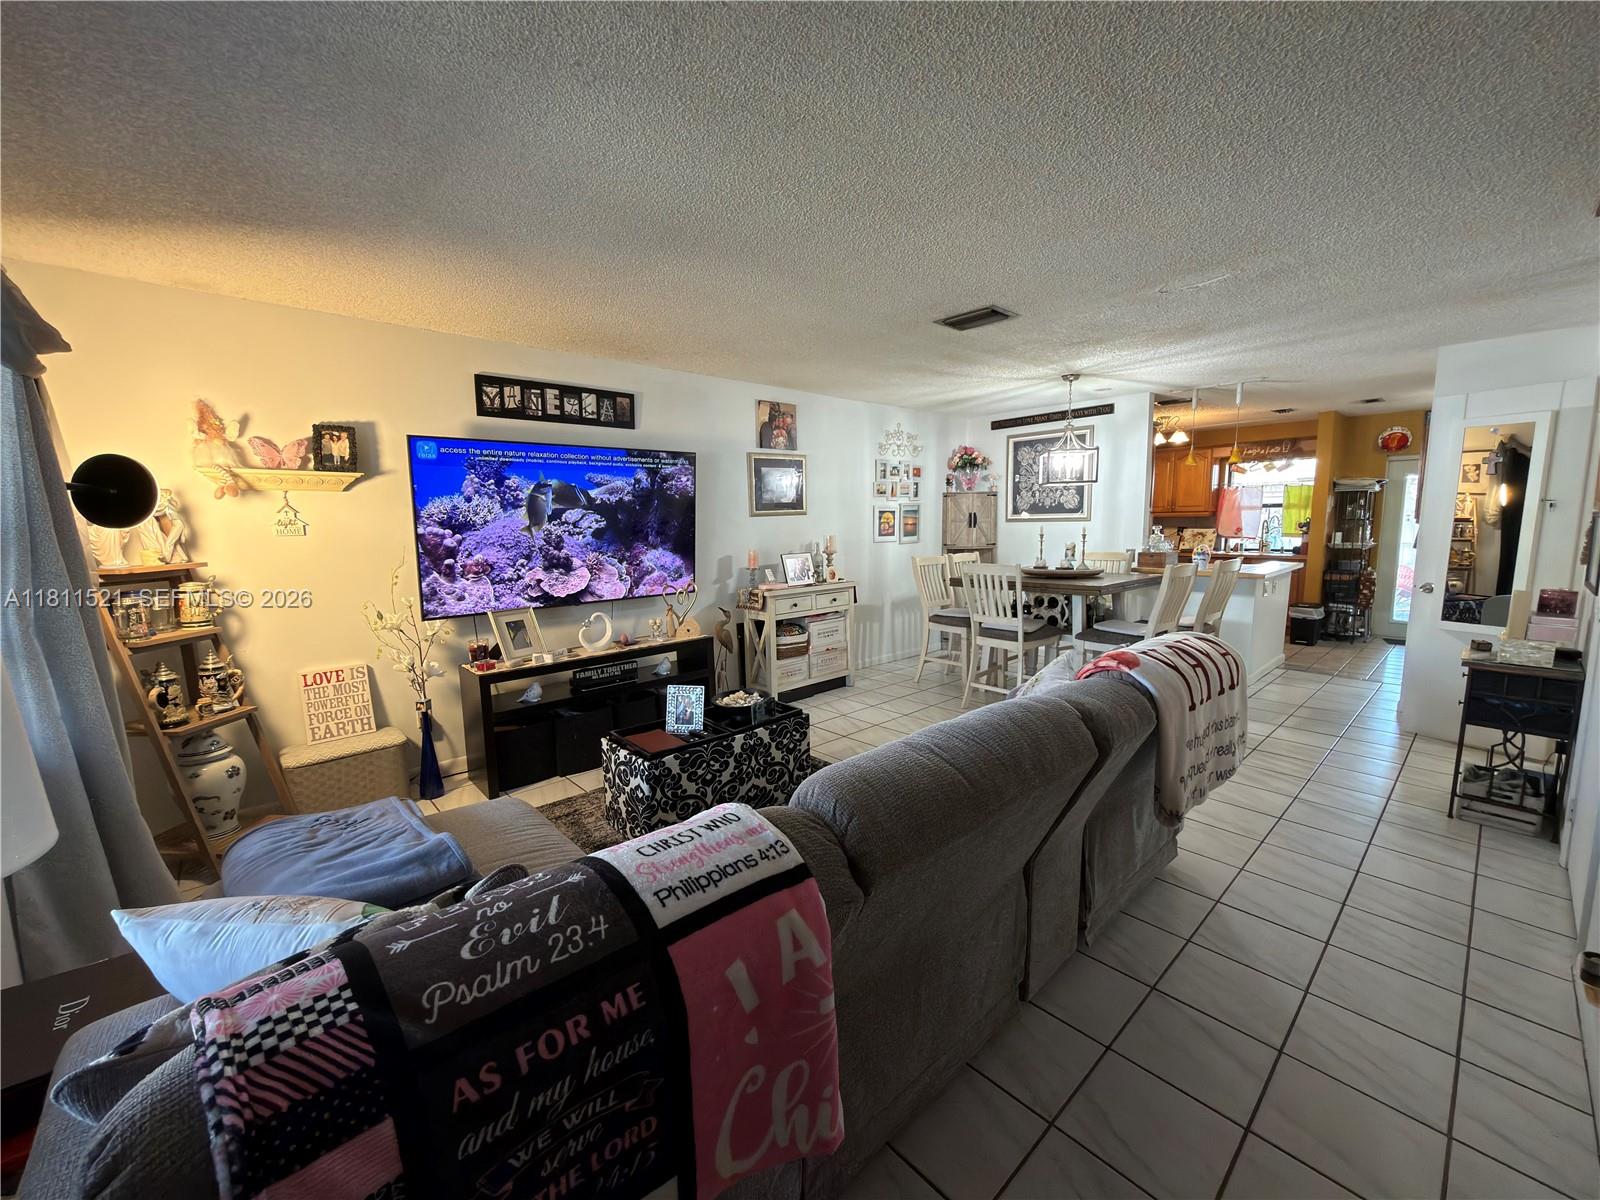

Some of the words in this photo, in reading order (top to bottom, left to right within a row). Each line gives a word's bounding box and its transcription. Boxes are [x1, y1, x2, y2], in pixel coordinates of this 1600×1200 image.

[483, 448, 503, 456] entire
[504, 449, 526, 457] nature
[528, 450, 559, 458] relaxation
[591, 454, 612, 462] without
[613, 456, 653, 464] advertisements
[301, 669, 345, 688] LOVE
[349, 666, 366, 681] IS
[304, 686, 330, 701] THE
[332, 679, 367, 697] MOST
[576, 668, 602, 679] FAMILY
[603, 662, 637, 673] TOGETHER
[306, 692, 370, 713] POWERFUL
[308, 707, 352, 726] FORCE
[354, 703, 371, 718] ON
[309, 716, 374, 742] EARTH
[635, 827, 702, 857] CHRIST
[698, 812, 742, 833] WHO
[652, 854, 759, 908] Philippians
[758, 839, 791, 862] 4:13
[460, 894, 570, 960] Evil
[476, 901, 513, 921] no
[422, 954, 541, 1024] Psalm
[52, 994, 91, 1031] Dior
[453, 1060, 502, 1114] AS
[514, 1013, 592, 1076] FOR
[600, 981, 648, 1025] ME
[457, 1090, 521, 1161] and
[527, 1073, 577, 1122] my
[507, 1128, 552, 1169] WE
[562, 1089, 620, 1130] WILL
[715, 1058, 842, 1179] Chi
[590, 1115, 658, 1172] LORD
